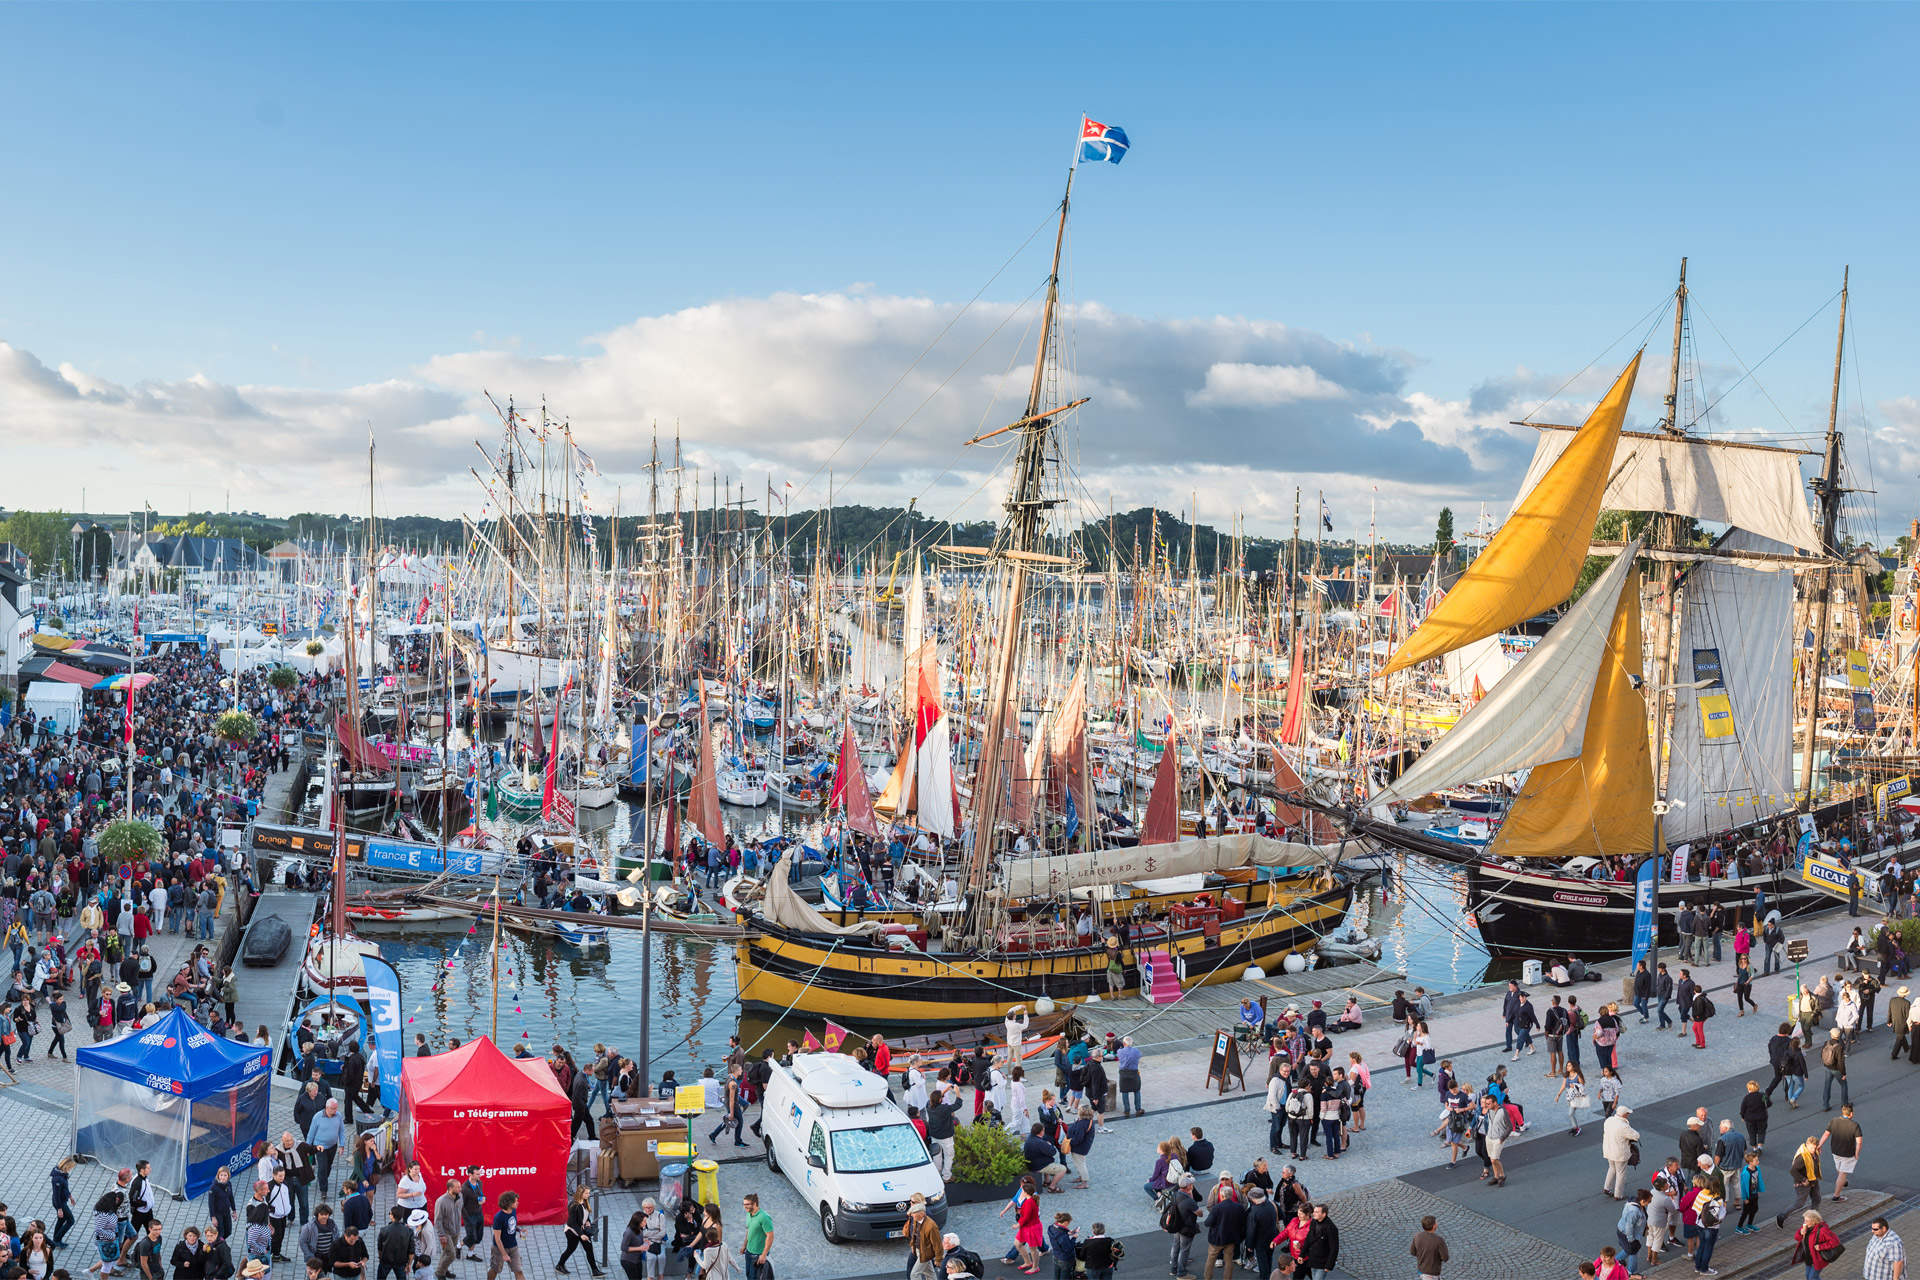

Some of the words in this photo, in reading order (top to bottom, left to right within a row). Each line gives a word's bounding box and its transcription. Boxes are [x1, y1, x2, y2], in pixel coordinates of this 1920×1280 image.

[1888, 781, 1907, 794] CARD
[258, 834, 288, 845] Orange
[374, 849, 407, 861] france
[430, 855, 463, 866] france
[1673, 855, 1683, 883] ILLET
[1811, 867, 1849, 886] RICAR
[139, 1036, 163, 1046] france
[147, 1033, 167, 1042] ouest
[188, 1037, 210, 1049] france
[245, 1055, 261, 1068] ouest
[243, 1062, 261, 1076] france
[146, 1077, 171, 1092] france
[148, 1073, 171, 1085] ouest
[467, 1109, 529, 1119] Télégramme
[230, 1143, 252, 1165] ouest
[441, 1166, 455, 1176] Le
[459, 1165, 537, 1178] Tégramme
